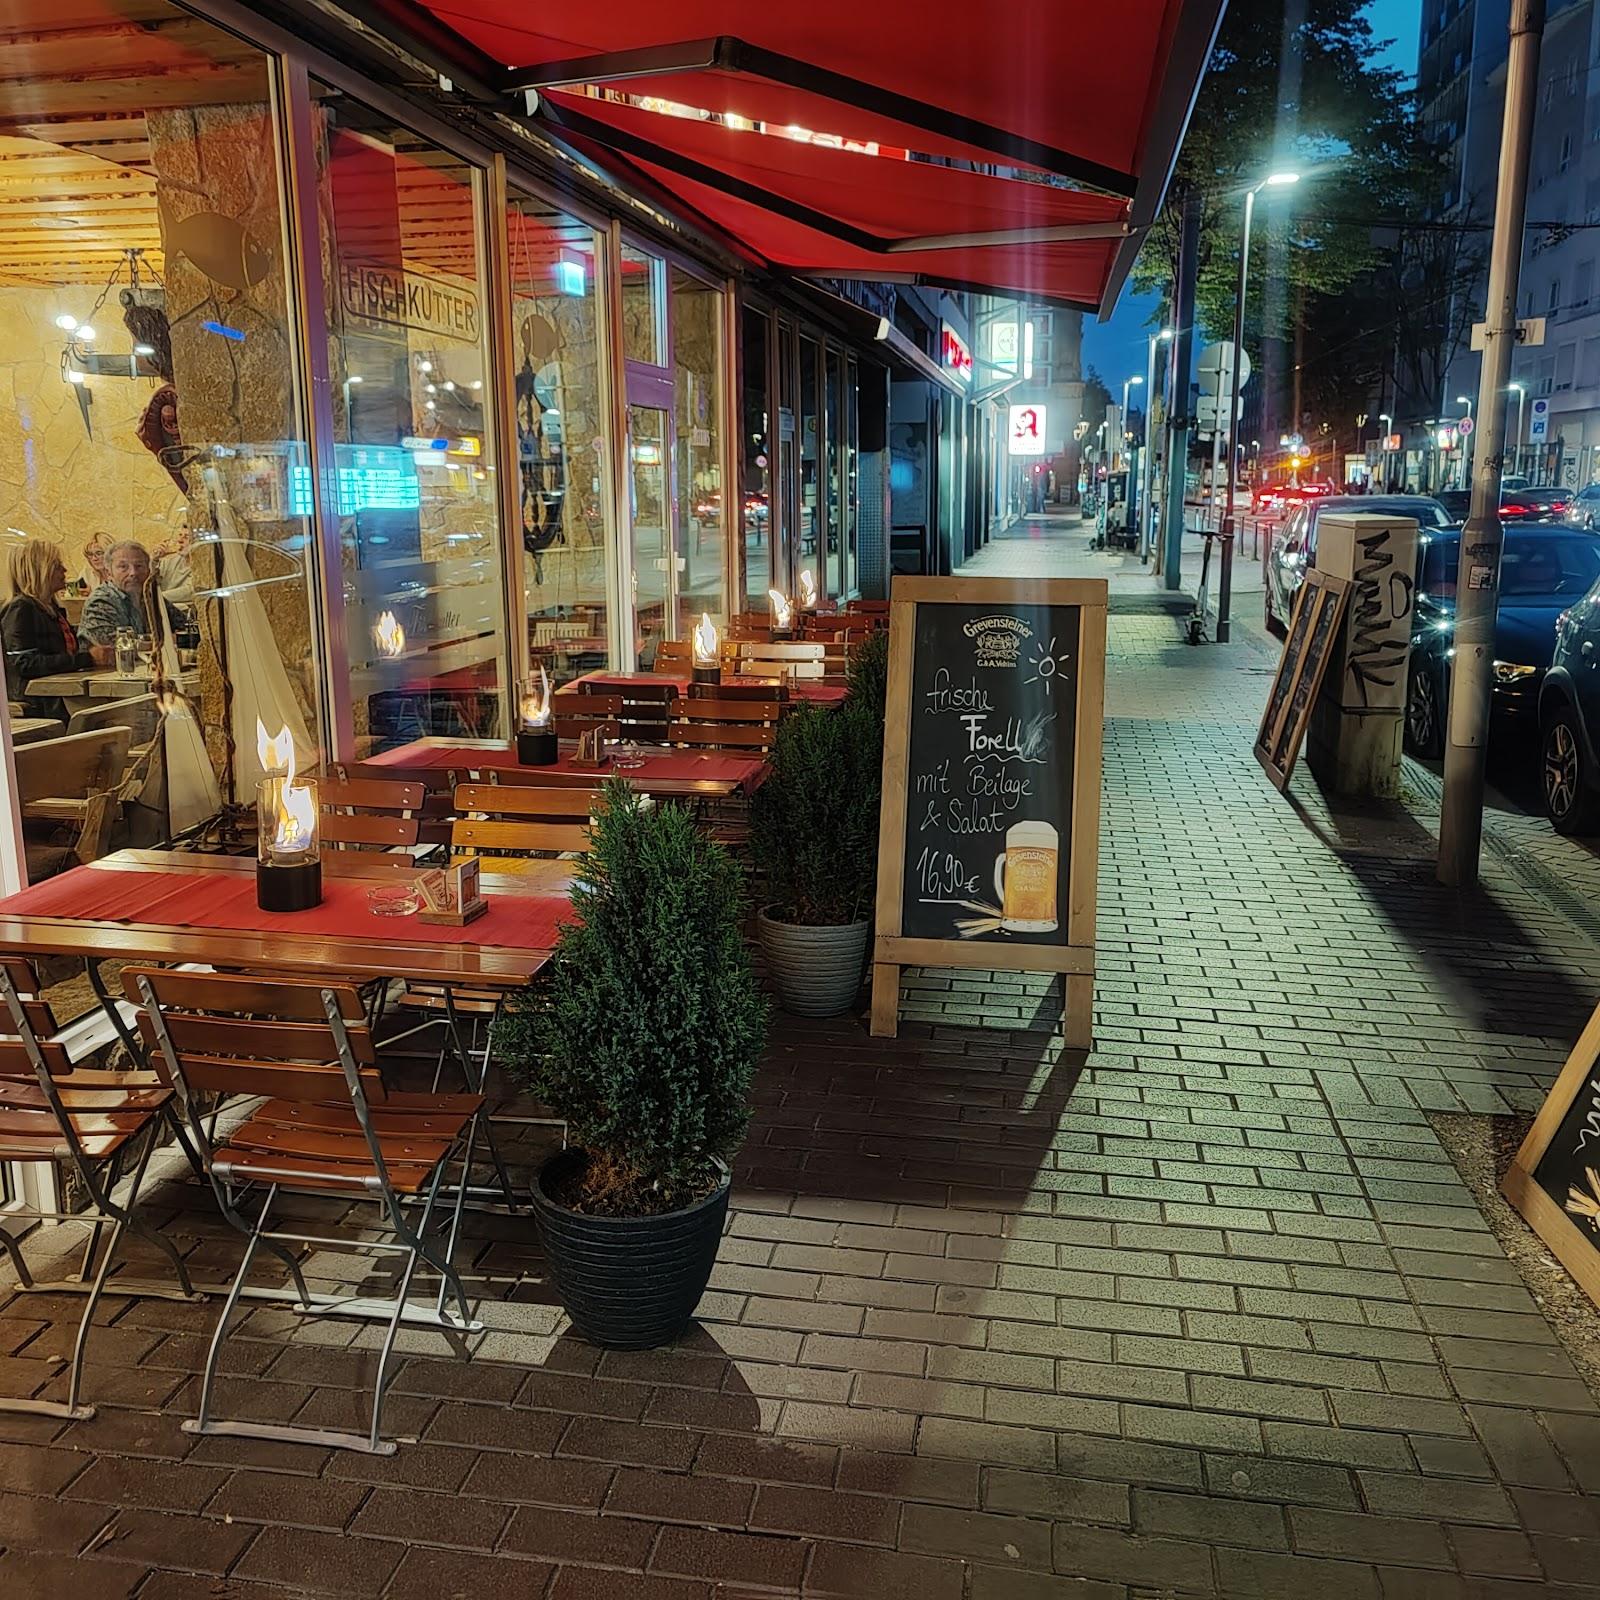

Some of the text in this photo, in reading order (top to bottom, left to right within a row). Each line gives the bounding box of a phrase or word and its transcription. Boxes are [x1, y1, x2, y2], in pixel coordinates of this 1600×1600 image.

[345, 264, 476, 333] FISCHKUTTER
[962, 617, 1034, 639] Grevensteiner
[926, 667, 996, 711] frische
[916, 759, 1033, 810] mit Beilage
[920, 797, 1005, 834] & Salat
